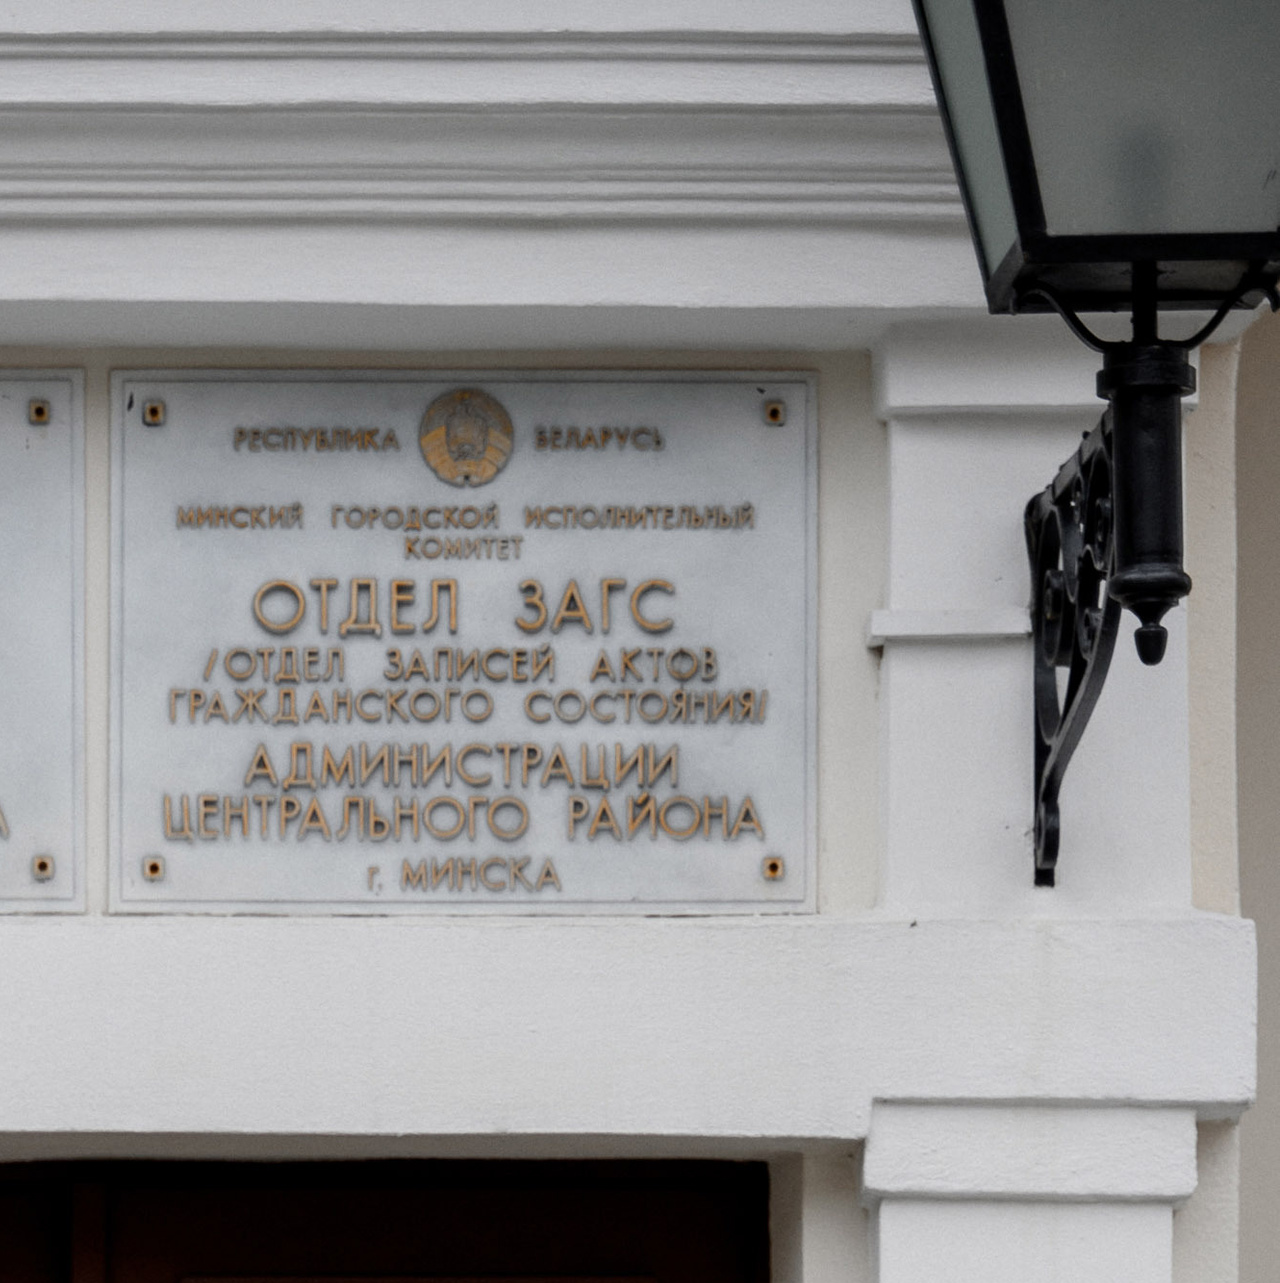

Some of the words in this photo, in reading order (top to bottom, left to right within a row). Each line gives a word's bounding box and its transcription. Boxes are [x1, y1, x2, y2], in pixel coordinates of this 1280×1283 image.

[234, 425, 399, 453] РЕСПУБЛИКА
[535, 425, 663, 451] БЕЛАРУСЬ
[177, 503, 304, 529] МИНСКИЙ
[332, 502, 499, 531] ГОРОДСКОЙ
[525, 503, 754, 529] ИСПОЛНИТЕЛЬНЫЙ
[405, 535, 523, 560] КОМИТЕТ
[253, 579, 458, 635] ОТДЕЛ
[516, 580, 675, 632] ЗАГС
[204, 647, 344, 681] /ОТДЕЛ
[384, 645, 554, 681] ЗАПИСЕЙ
[590, 647, 717, 681] АКТОВ
[169, 688, 493, 723] ГРАЖДАНСКОГО
[525, 690, 768, 724] СОСТОЯНИЯ/
[245, 743, 678, 790] АДМИНИСТРАЦИИ
[164, 795, 529, 842] ЦЕНТРАЛЬНОГО
[568, 791, 763, 840] РАЙОНА
[402, 858, 560, 892] МИНСКА
